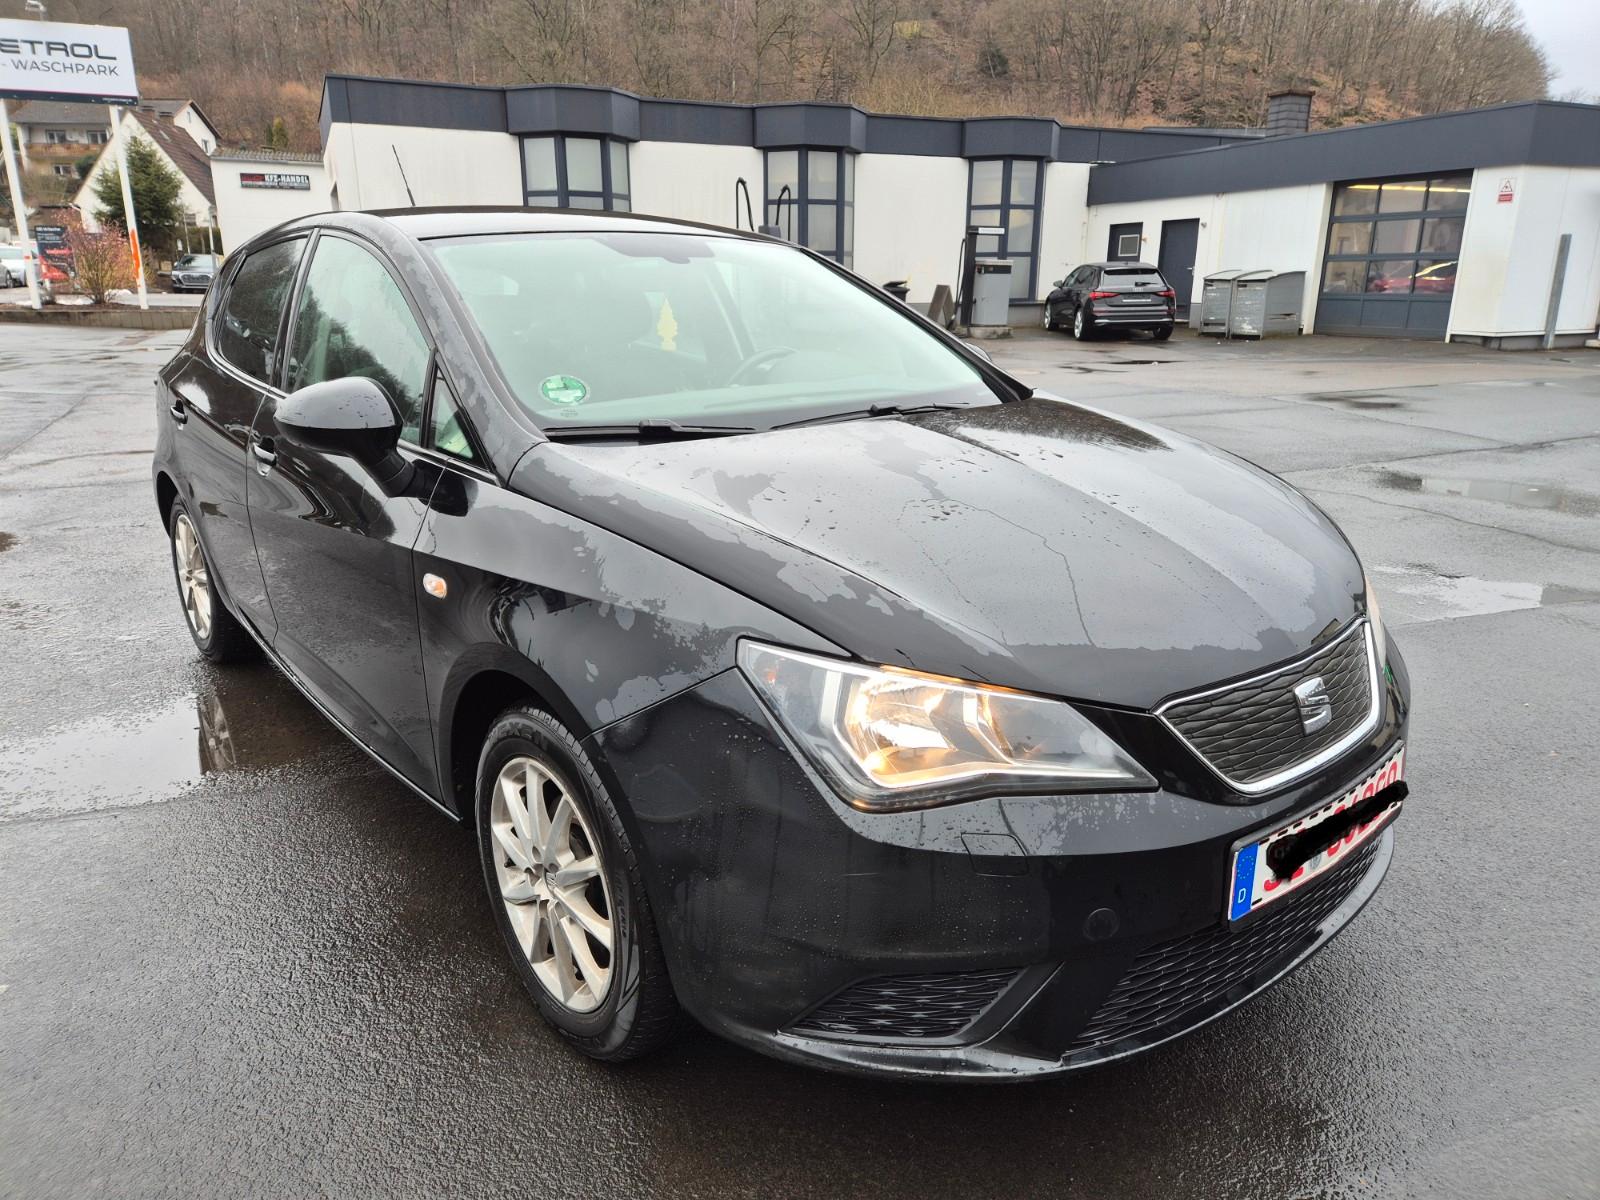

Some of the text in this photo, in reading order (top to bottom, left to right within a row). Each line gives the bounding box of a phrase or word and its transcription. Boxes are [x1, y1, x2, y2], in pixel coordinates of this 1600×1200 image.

[11, 59, 119, 76] WASCHPARK
[264, 173, 309, 184] KFZ-HANDEL
[1238, 888, 1247, 904] D
